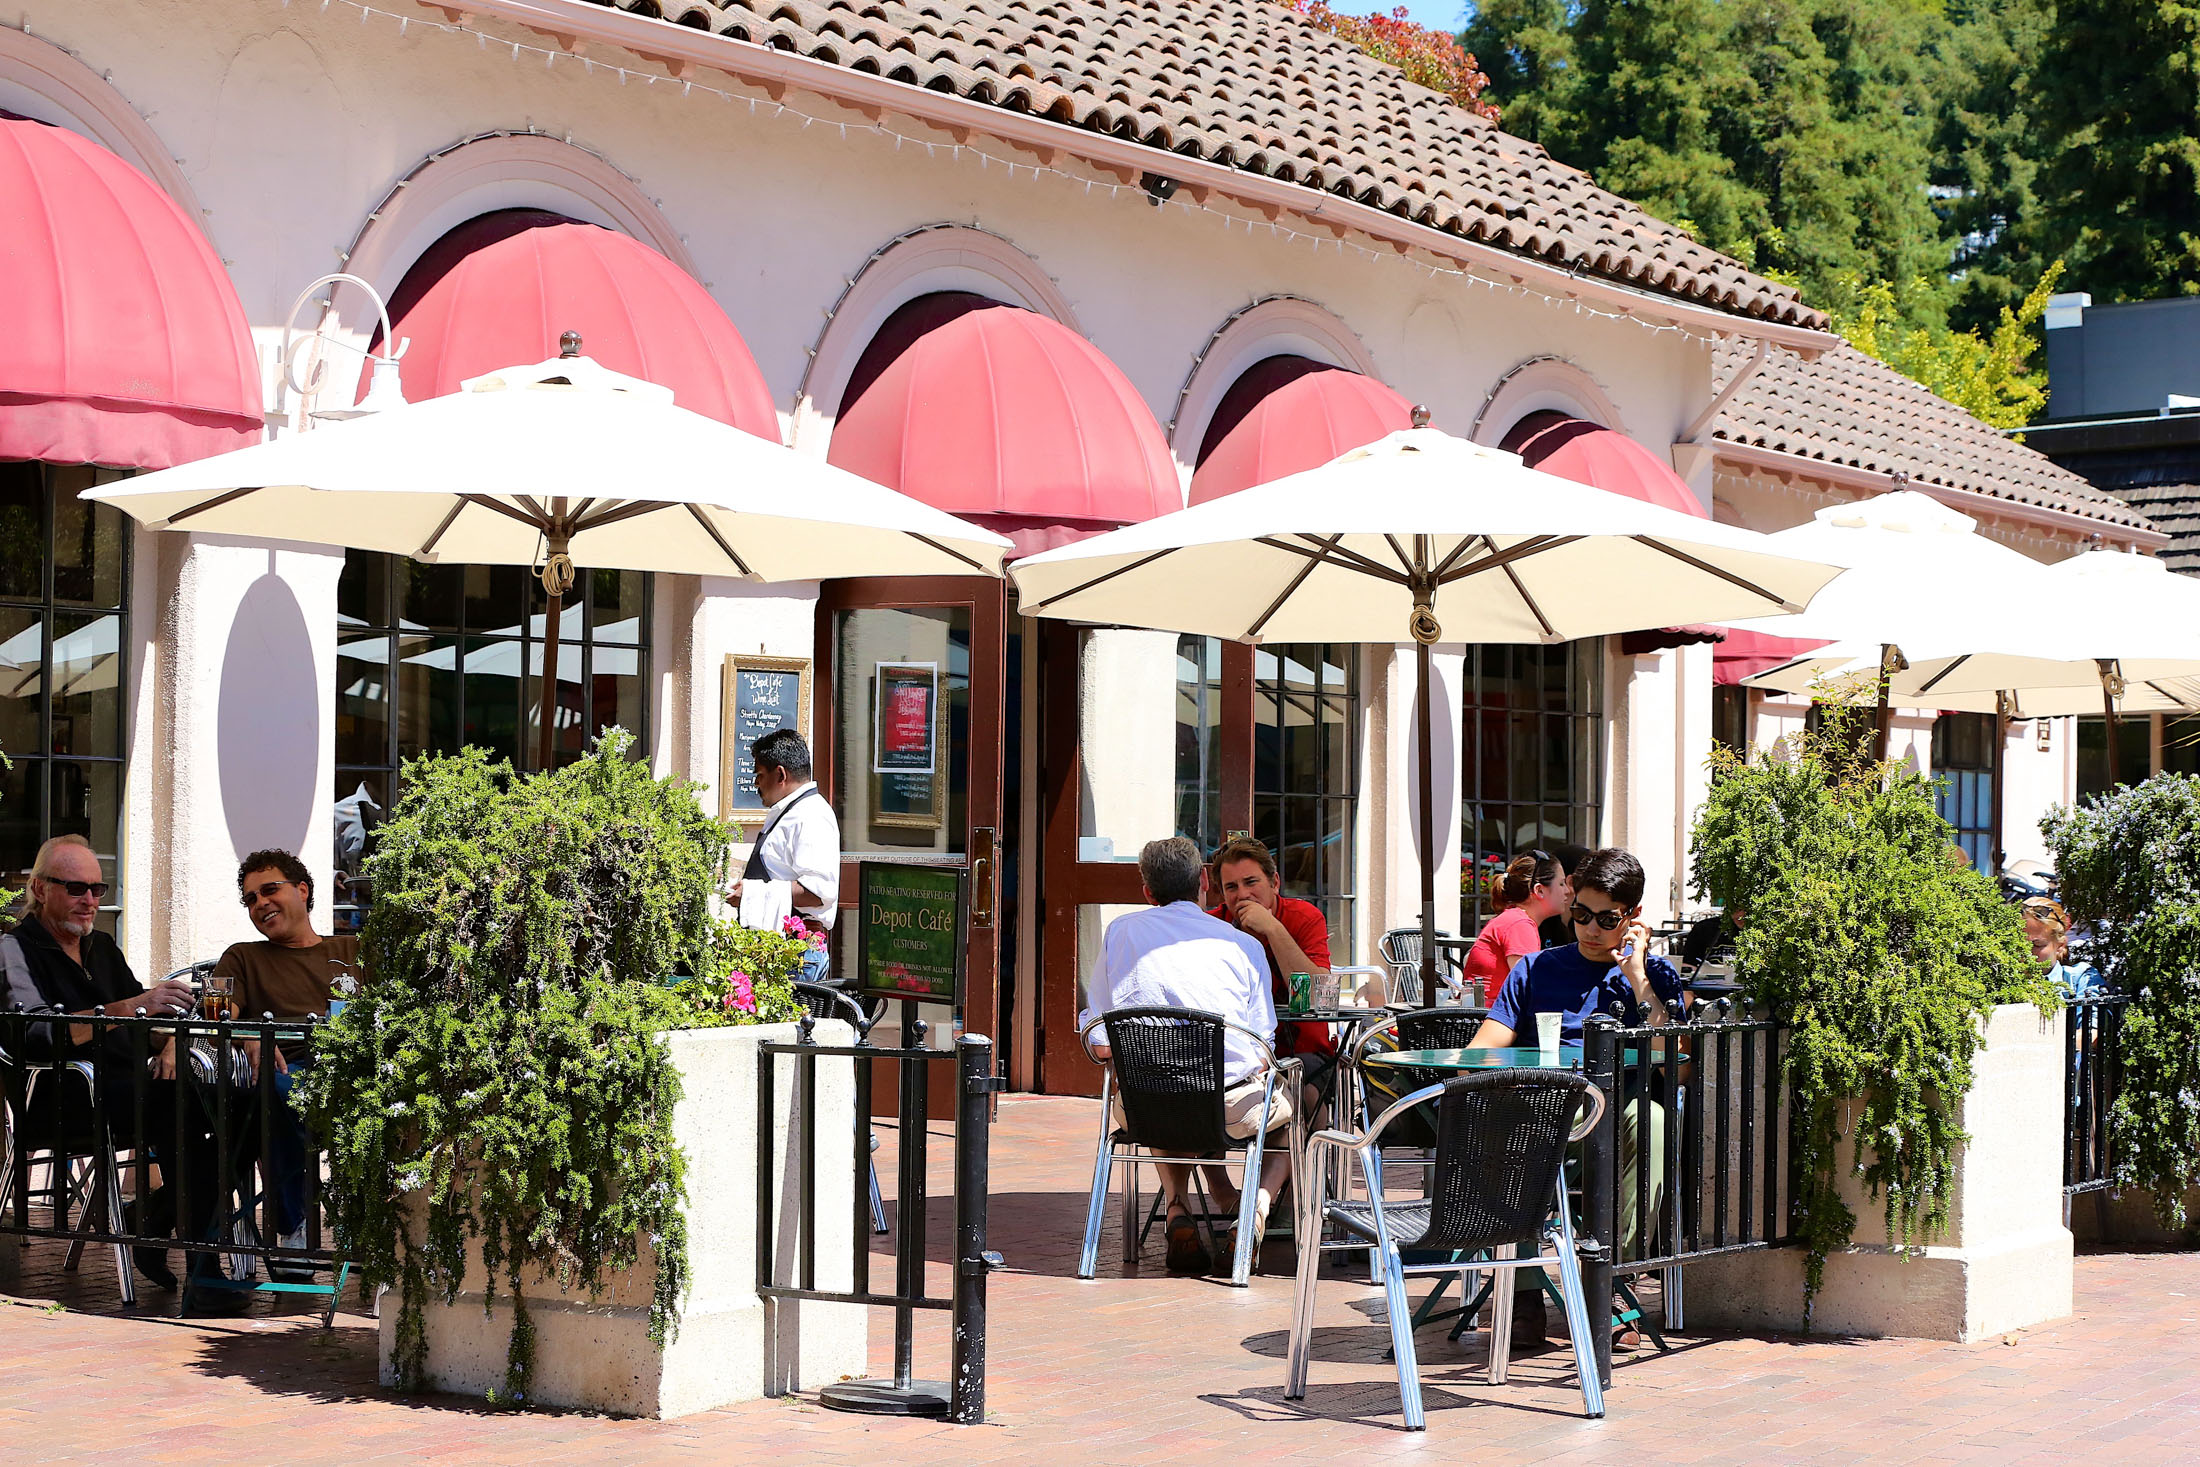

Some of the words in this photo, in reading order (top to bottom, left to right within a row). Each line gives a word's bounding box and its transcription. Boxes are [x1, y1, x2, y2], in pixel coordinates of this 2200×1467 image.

[868, 885, 885, 896] PATIO
[886, 886, 911, 898] SEATING
[912, 888, 943, 900] RESERVED
[944, 891, 957, 902] FOR
[871, 903, 912, 933] Depot
[918, 907, 952, 932] Café
[892, 937, 928, 951] CUSTOMERS
